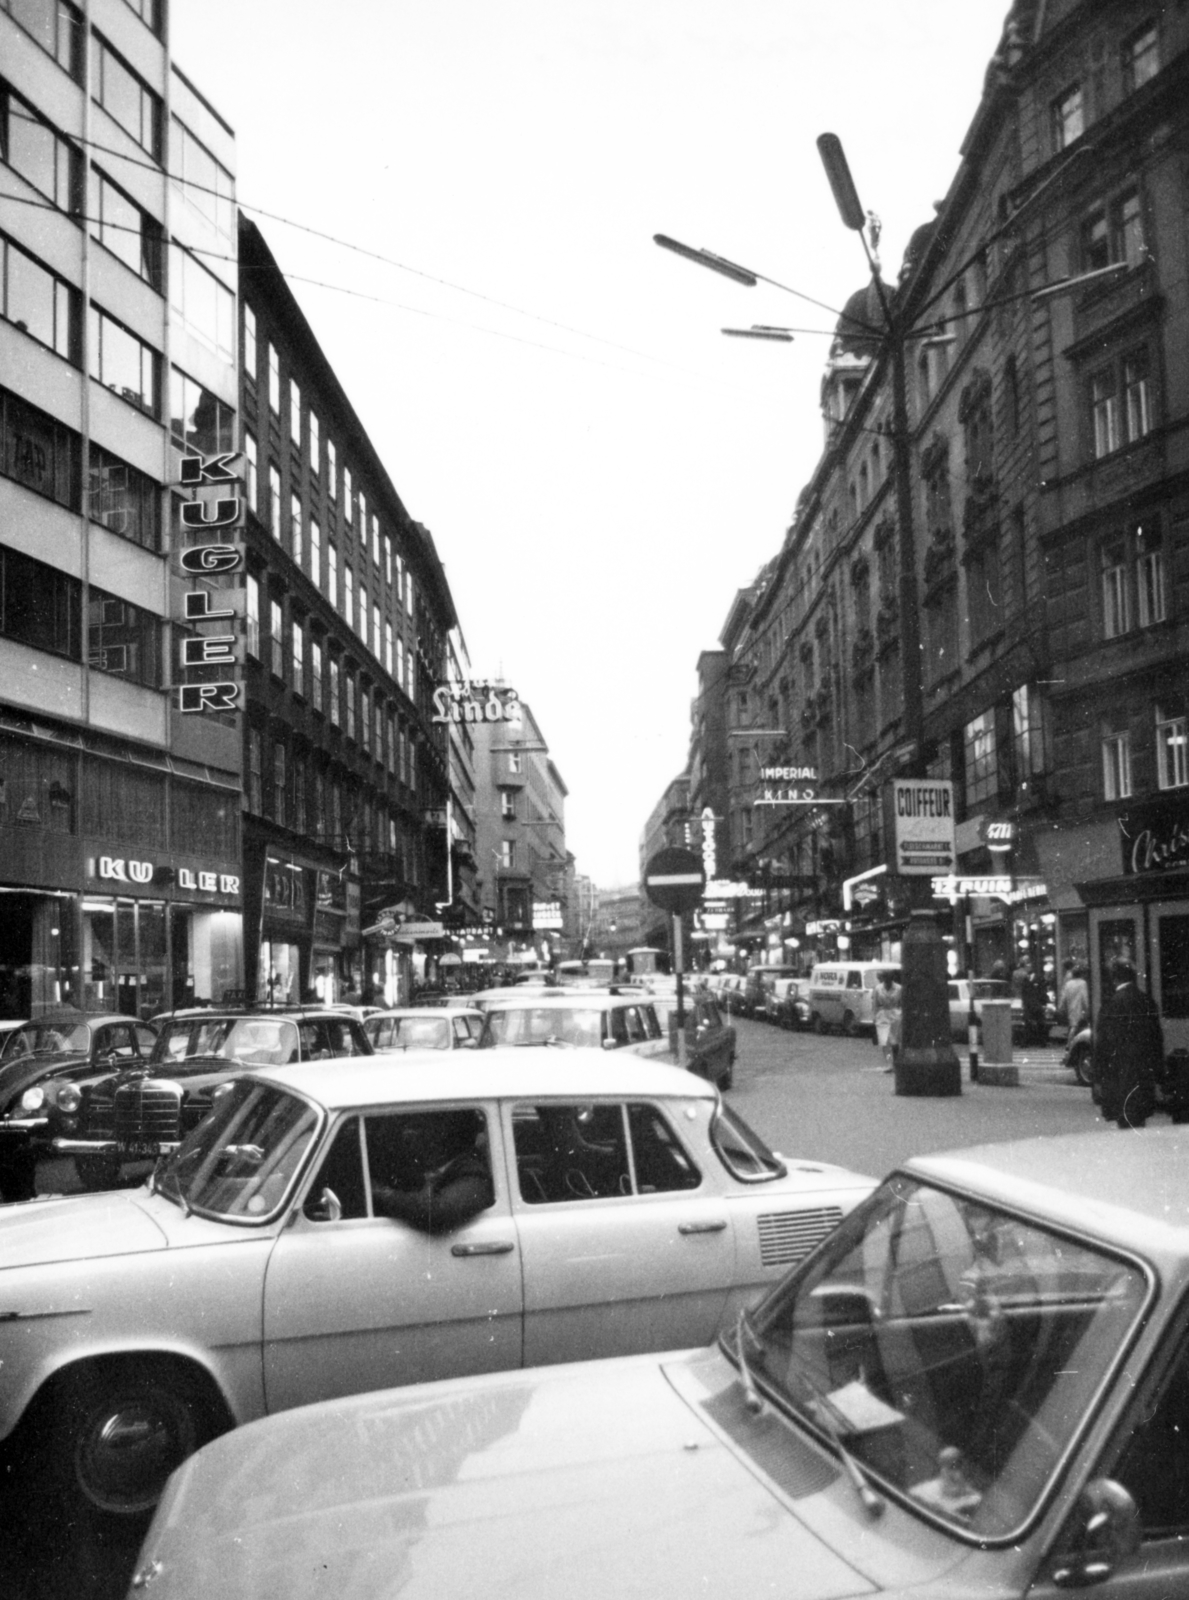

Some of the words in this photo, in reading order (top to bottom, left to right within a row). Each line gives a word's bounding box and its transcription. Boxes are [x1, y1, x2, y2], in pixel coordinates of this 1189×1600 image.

[180, 452, 242, 712] KUGLER
[432, 687, 522, 723] Linde
[761, 767, 817, 780] IMPERIAL
[764, 789, 815, 801] KINO
[897, 787, 951, 818] COIFFEUR
[987, 823, 1012, 839] 4711
